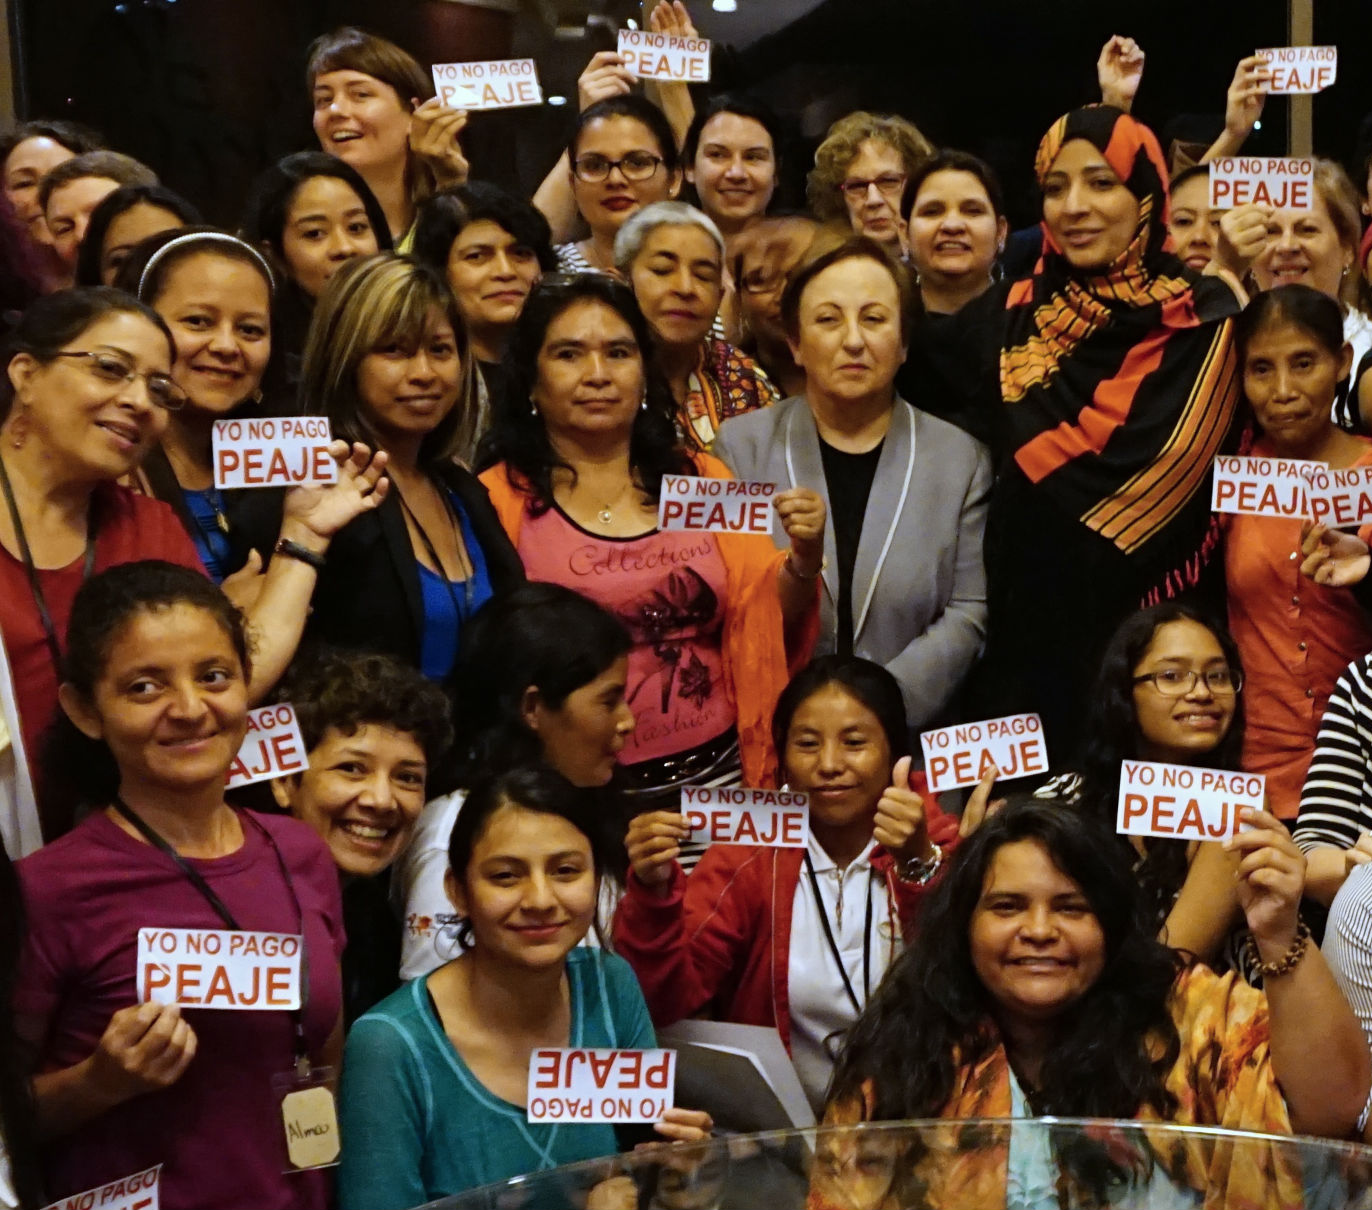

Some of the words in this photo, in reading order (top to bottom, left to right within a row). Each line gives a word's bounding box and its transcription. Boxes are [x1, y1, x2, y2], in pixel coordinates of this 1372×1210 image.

[620, 31, 640, 46] YO
[644, 34, 665, 49] NO
[669, 37, 708, 54] PAGO
[1278, 48, 1296, 63] NO
[434, 65, 458, 80] YO
[461, 64, 485, 78] NO
[489, 60, 533, 77] PAGO
[621, 49, 704, 78] PEAJE
[1212, 158, 1235, 174] YO
[1239, 159, 1263, 175] NO
[1267, 159, 1312, 175] PAGO
[1212, 179, 1309, 208] PEAJE
[216, 421, 242, 441] YO
[248, 420, 276, 440] NO
[281, 420, 328, 439] PAGO
[217, 445, 333, 485] PEAJE
[1217, 457, 1241, 474] YO
[1246, 459, 1272, 477] NO
[664, 477, 690, 495] YO
[695, 480, 722, 497] NO
[726, 481, 776, 497] PAGO
[1304, 473, 1330, 491] YO
[1334, 470, 1361, 488] NO
[661, 500, 769, 532] PEAJE
[246, 706, 293, 733] AGO
[923, 731, 950, 750] YO
[955, 725, 982, 744] NO
[987, 716, 1040, 739] PAGO
[929, 739, 1043, 789] PEAJE
[1125, 764, 1155, 786] YO
[1162, 767, 1194, 789] NO
[1200, 772, 1262, 798] PAGO
[683, 788, 712, 804] YO
[717, 789, 746, 805] NO
[752, 790, 808, 807] PAGO
[686, 810, 804, 844] PEAJE
[144, 931, 177, 954] YO
[186, 933, 221, 955] NO
[229, 934, 299, 957] PAGO
[143, 962, 292, 1006] PEAJE
[535, 1050, 671, 1089] PEAJE
[530, 1097, 593, 1119] PAGO
[600, 1097, 632, 1119] NO
[288, 1119, 330, 1144] Alma
[100, 1167, 158, 1206] PAGO
